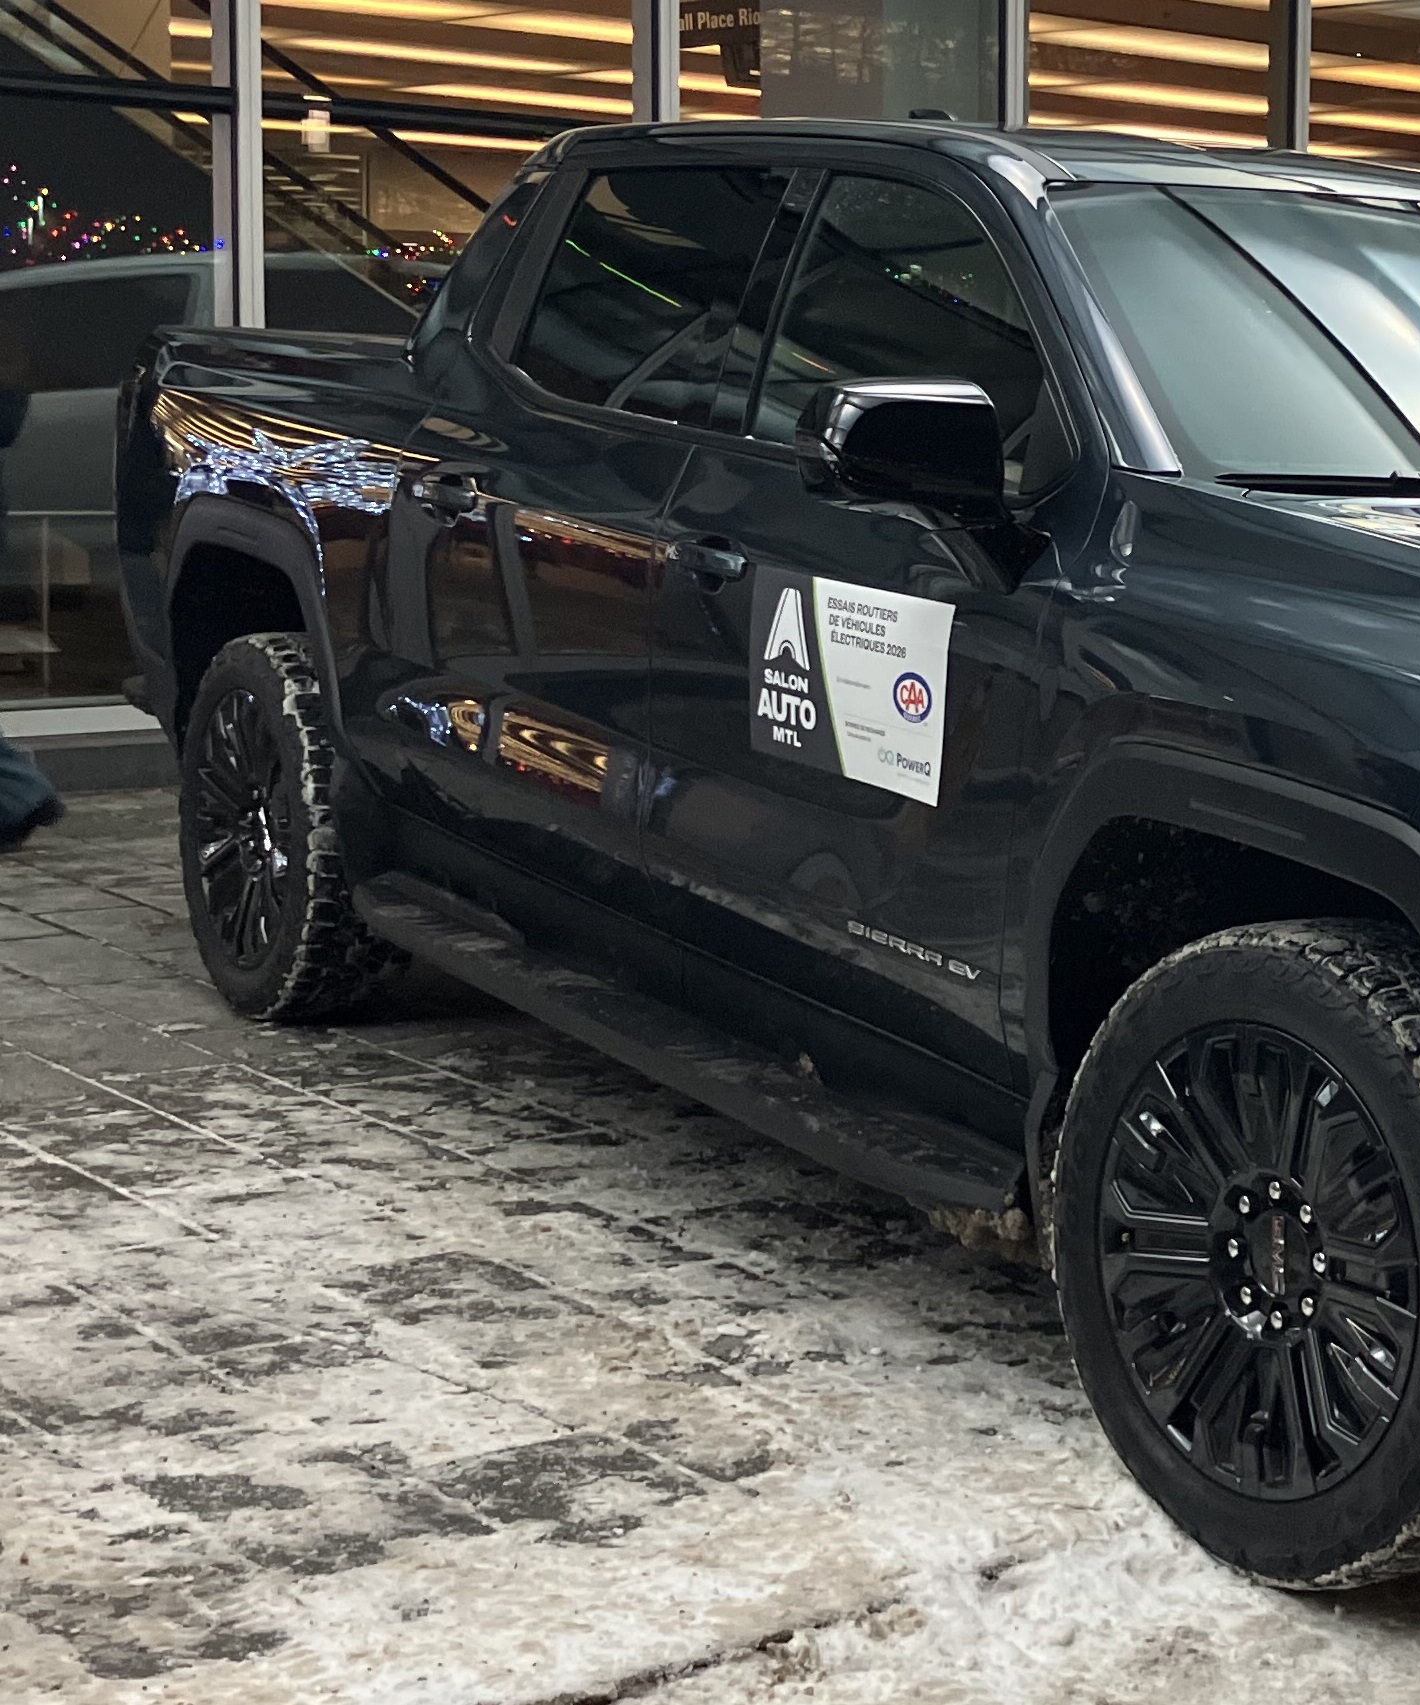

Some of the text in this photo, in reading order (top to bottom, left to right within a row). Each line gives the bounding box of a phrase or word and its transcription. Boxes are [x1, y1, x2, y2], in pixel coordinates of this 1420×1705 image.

[697, 11, 734, 30] Place
[739, 8, 760, 26] Rio
[827, 597, 898, 622] ESSAIS ROUTIERS
[829, 614, 886, 637] DE VÉHICULES
[830, 629, 885, 653] ÉLECTRIQUES
[764, 668, 809, 694] SALON
[757, 687, 817, 730] AUTO
[900, 681, 925, 714] CAA
[772, 725, 802, 748] MTL
[847, 919, 982, 981] SIERRA EV
